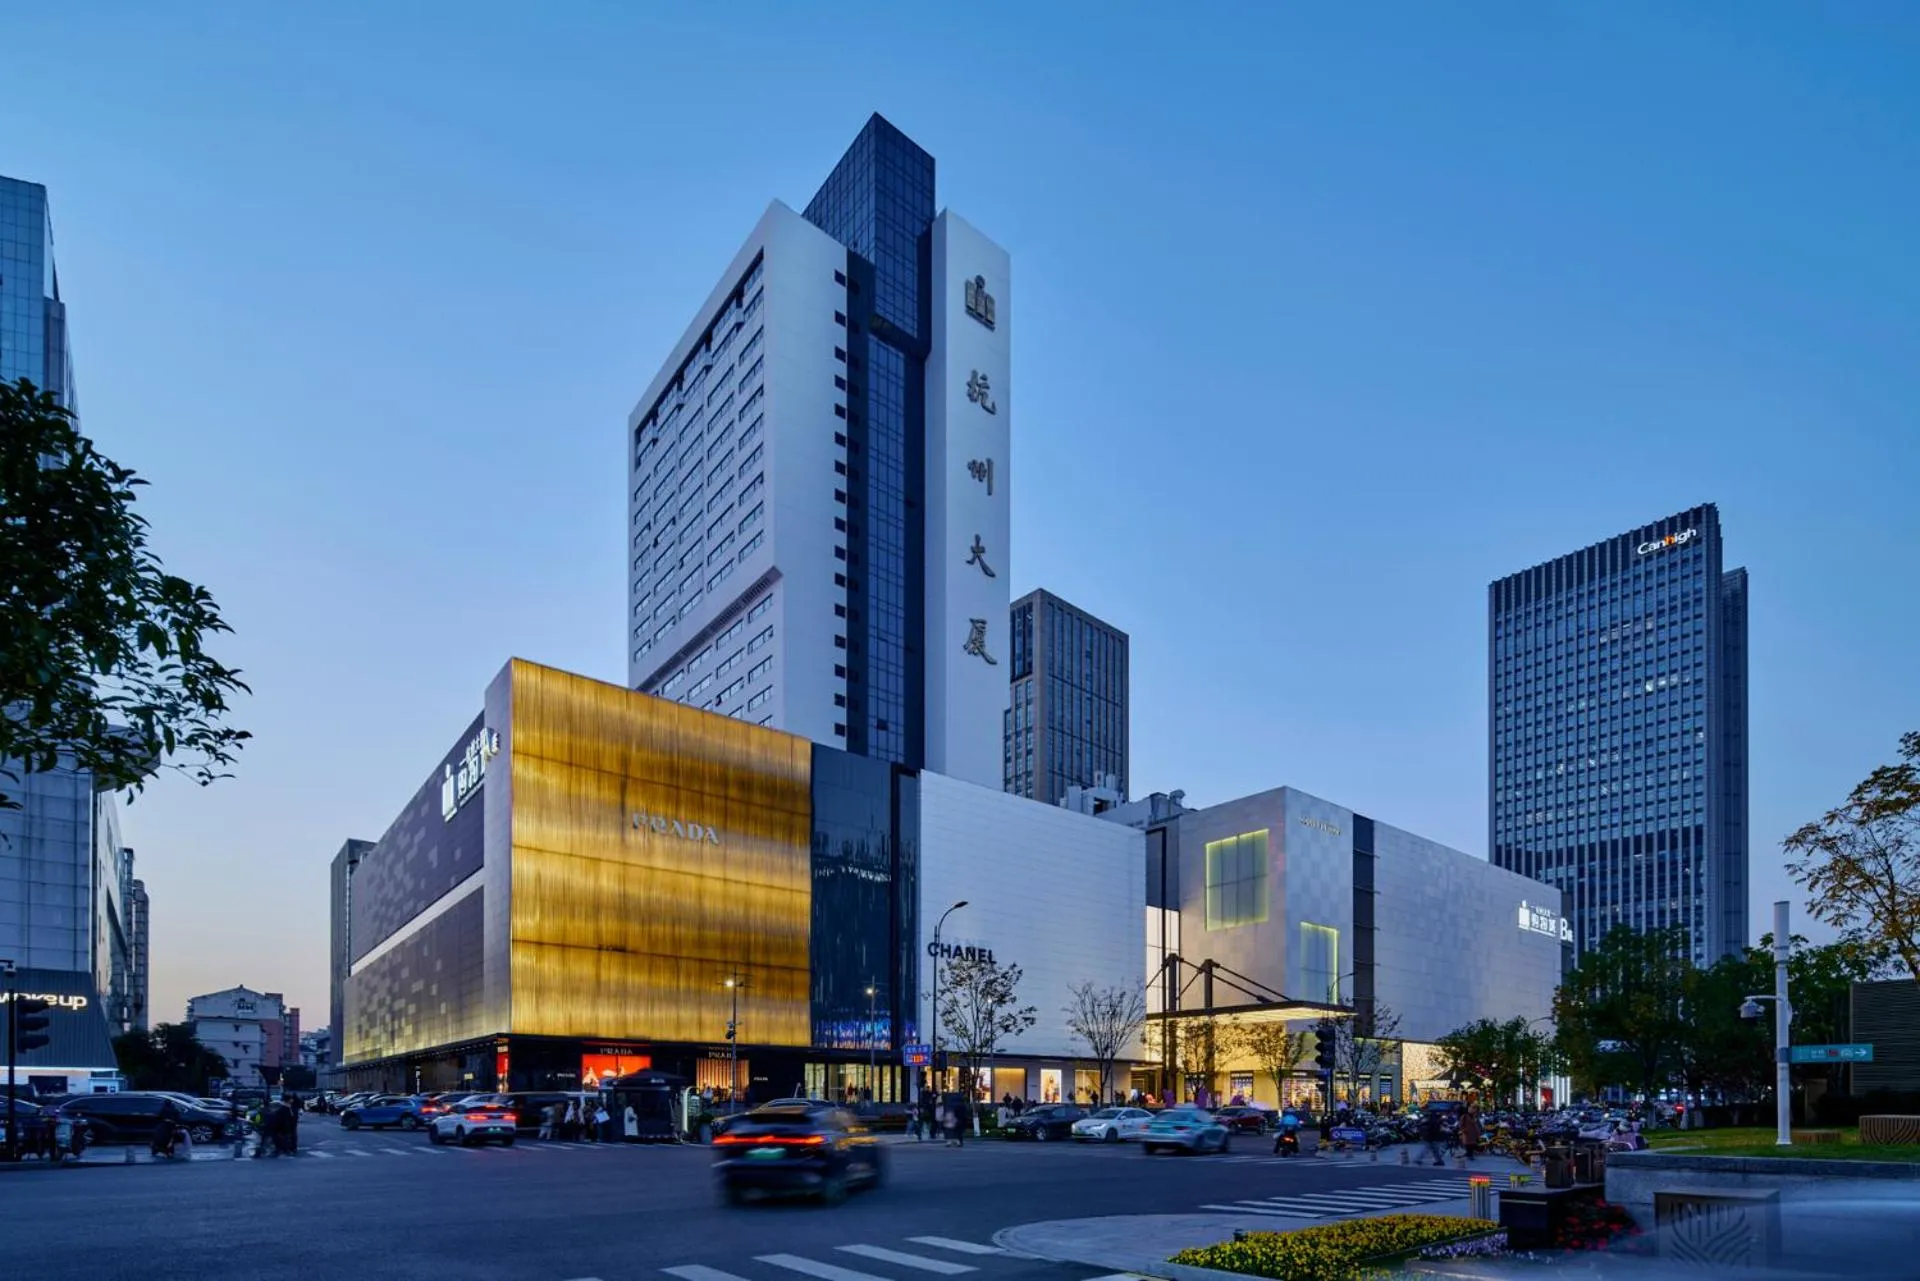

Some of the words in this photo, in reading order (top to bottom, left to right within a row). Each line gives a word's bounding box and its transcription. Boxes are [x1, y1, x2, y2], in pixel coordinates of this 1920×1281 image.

[964, 368, 998, 666] 杭州大厦
[1637, 527, 1697, 555] Canhigh
[632, 813, 719, 845] PRADA
[928, 942, 997, 965] CHANEL
